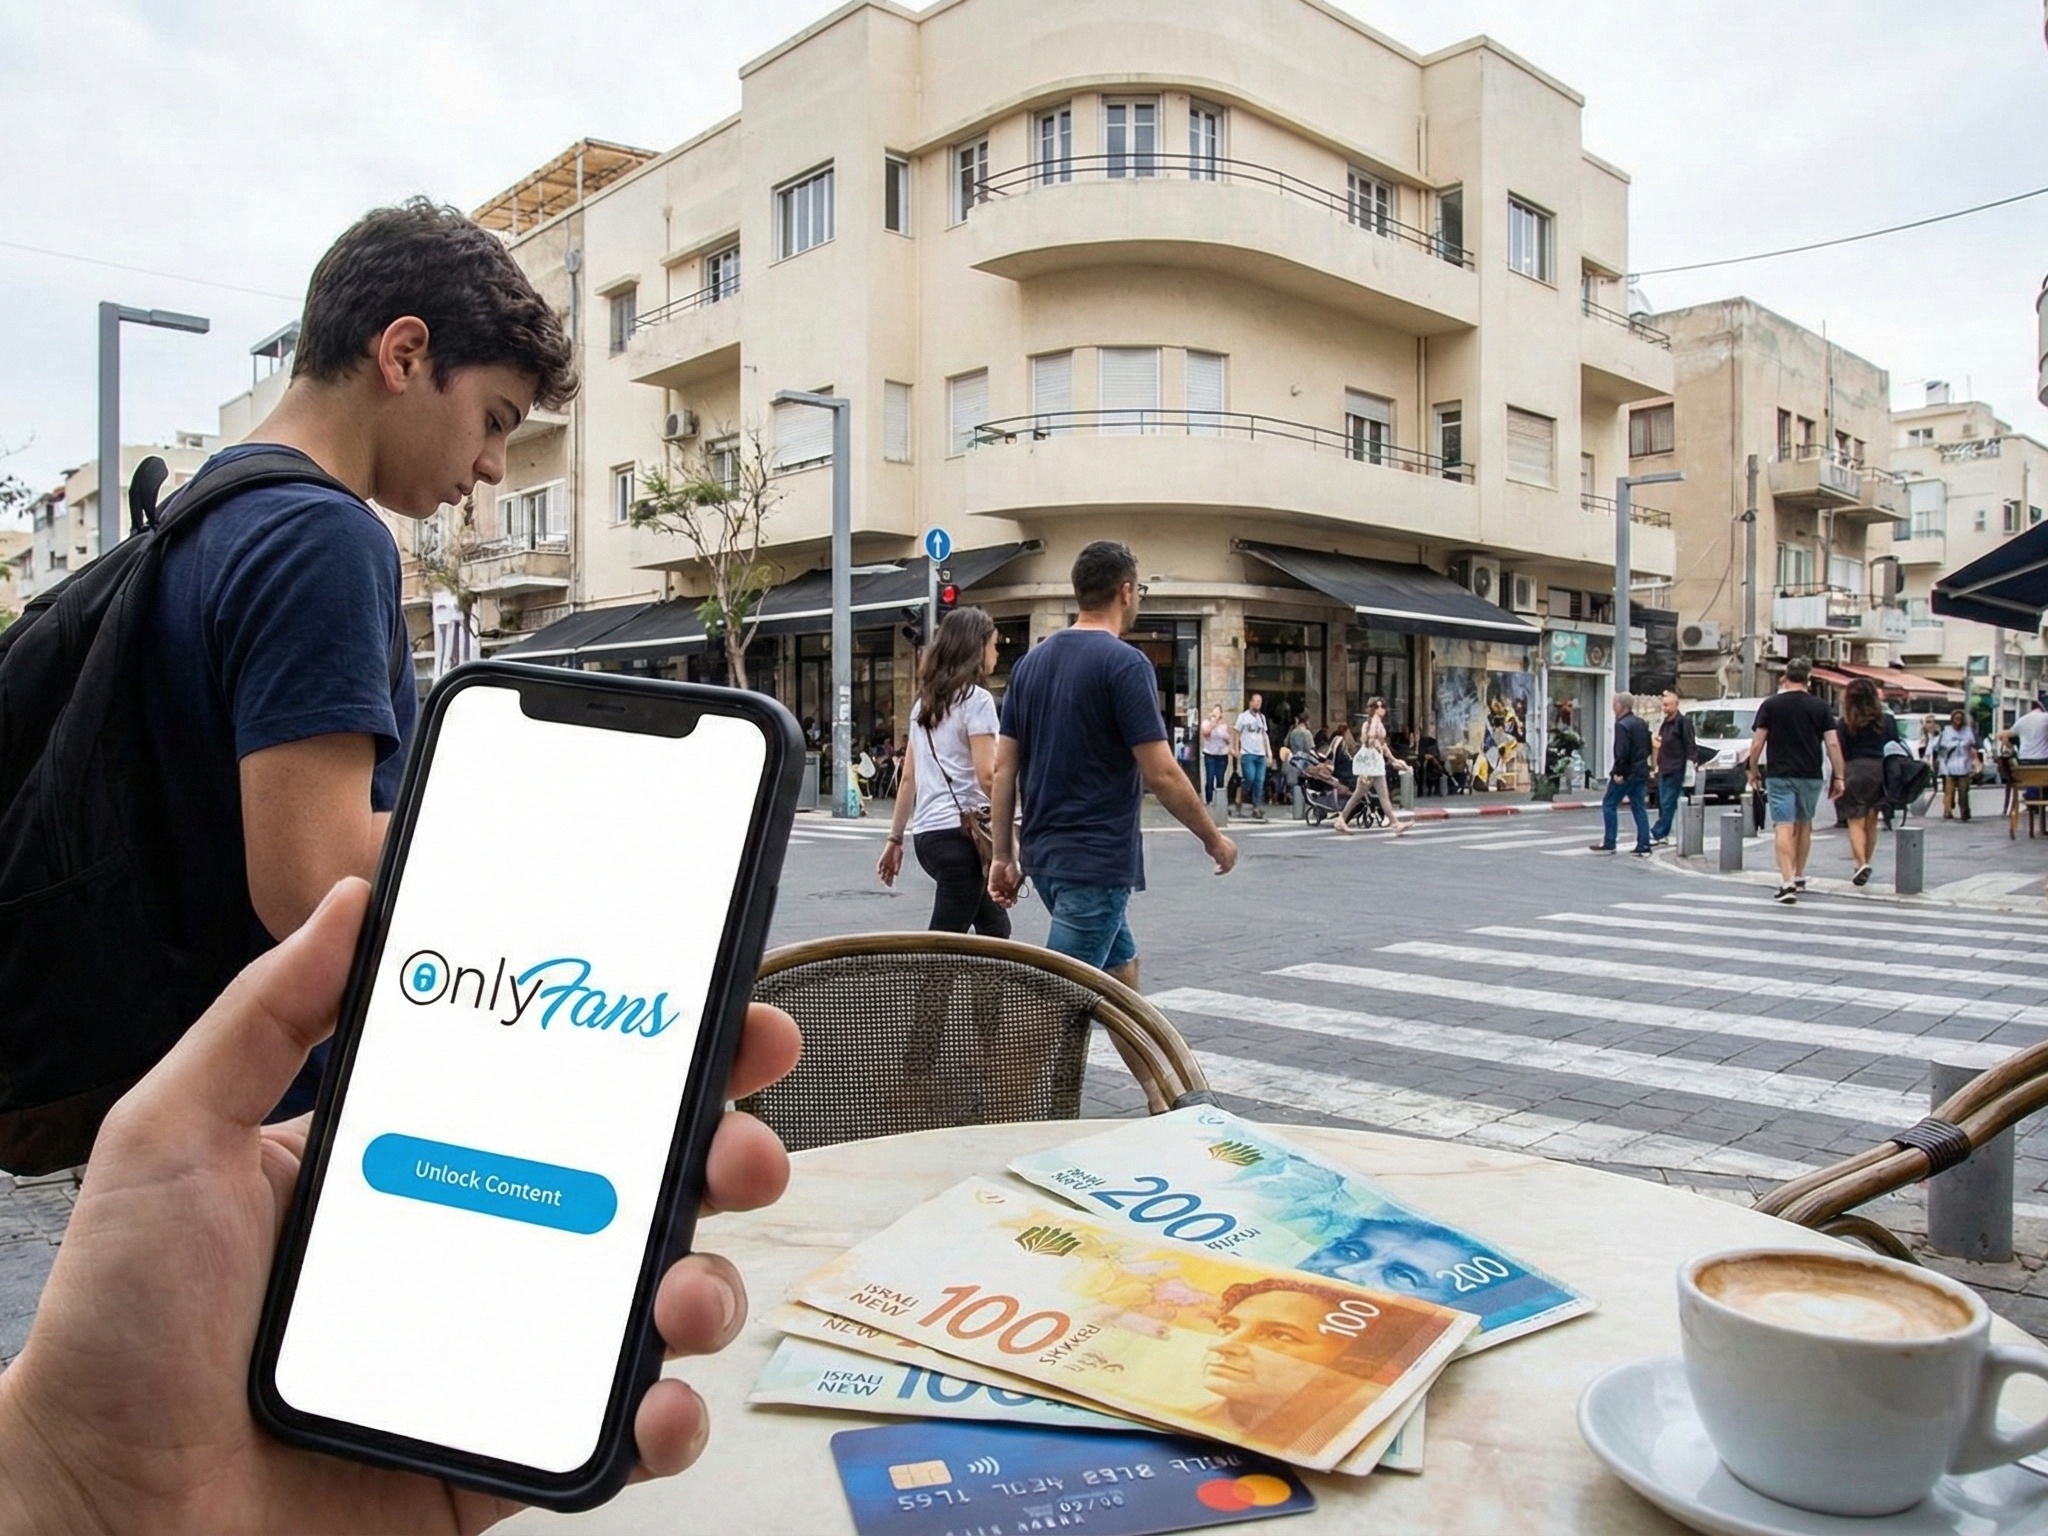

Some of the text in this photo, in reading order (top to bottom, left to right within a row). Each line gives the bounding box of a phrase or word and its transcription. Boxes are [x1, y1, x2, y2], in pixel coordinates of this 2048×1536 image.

[400, 949, 680, 1038] OnlyFans
[415, 1159, 562, 1207] Unlock Content
[1088, 1176, 1238, 1242] 200
[1435, 1256, 1510, 1293] 200
[850, 1292, 911, 1317] NEW
[917, 1284, 1071, 1355] 100
[1317, 1299, 1381, 1338] 100
[822, 1317, 883, 1339] NEW
[817, 1380, 880, 1396] NEW
